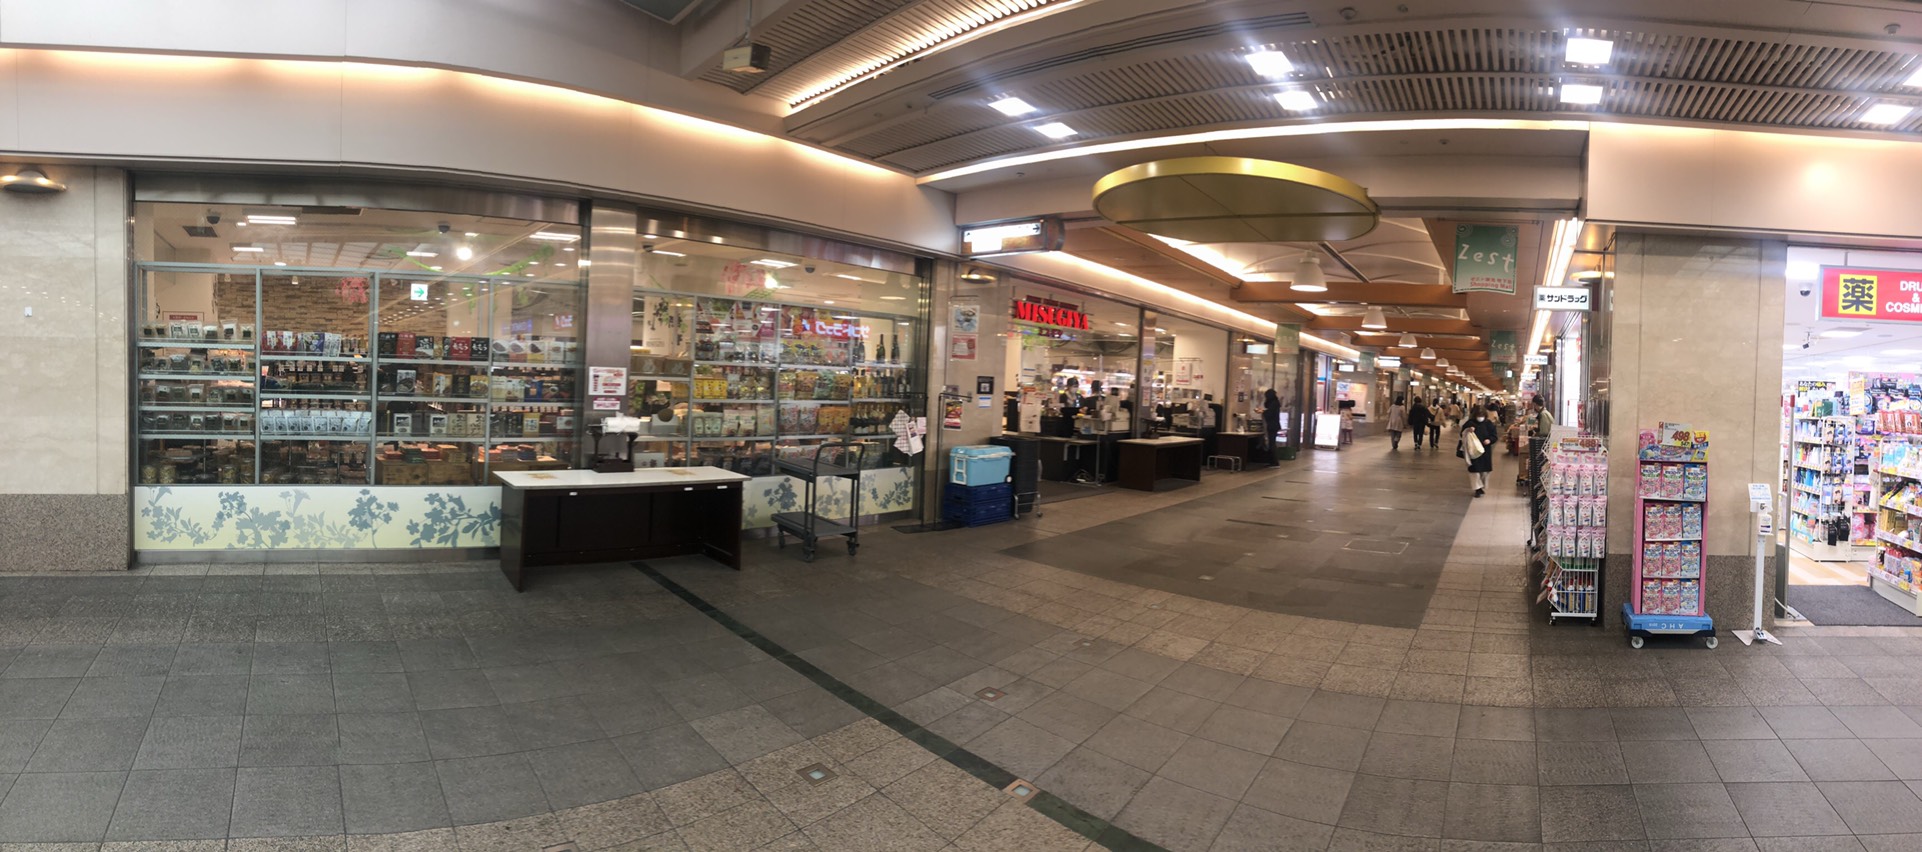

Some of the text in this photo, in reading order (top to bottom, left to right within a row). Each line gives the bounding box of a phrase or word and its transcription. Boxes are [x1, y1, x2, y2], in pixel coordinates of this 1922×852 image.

[1458, 243, 1515, 273] Zest
[1547, 294, 1588, 303] サンドラッグ
[1841, 277, 1874, 312] 薬
[1911, 292, 1921, 303] &
[1016, 300, 1089, 330] MISUGIYA
[1671, 430, 1690, 441] 498
